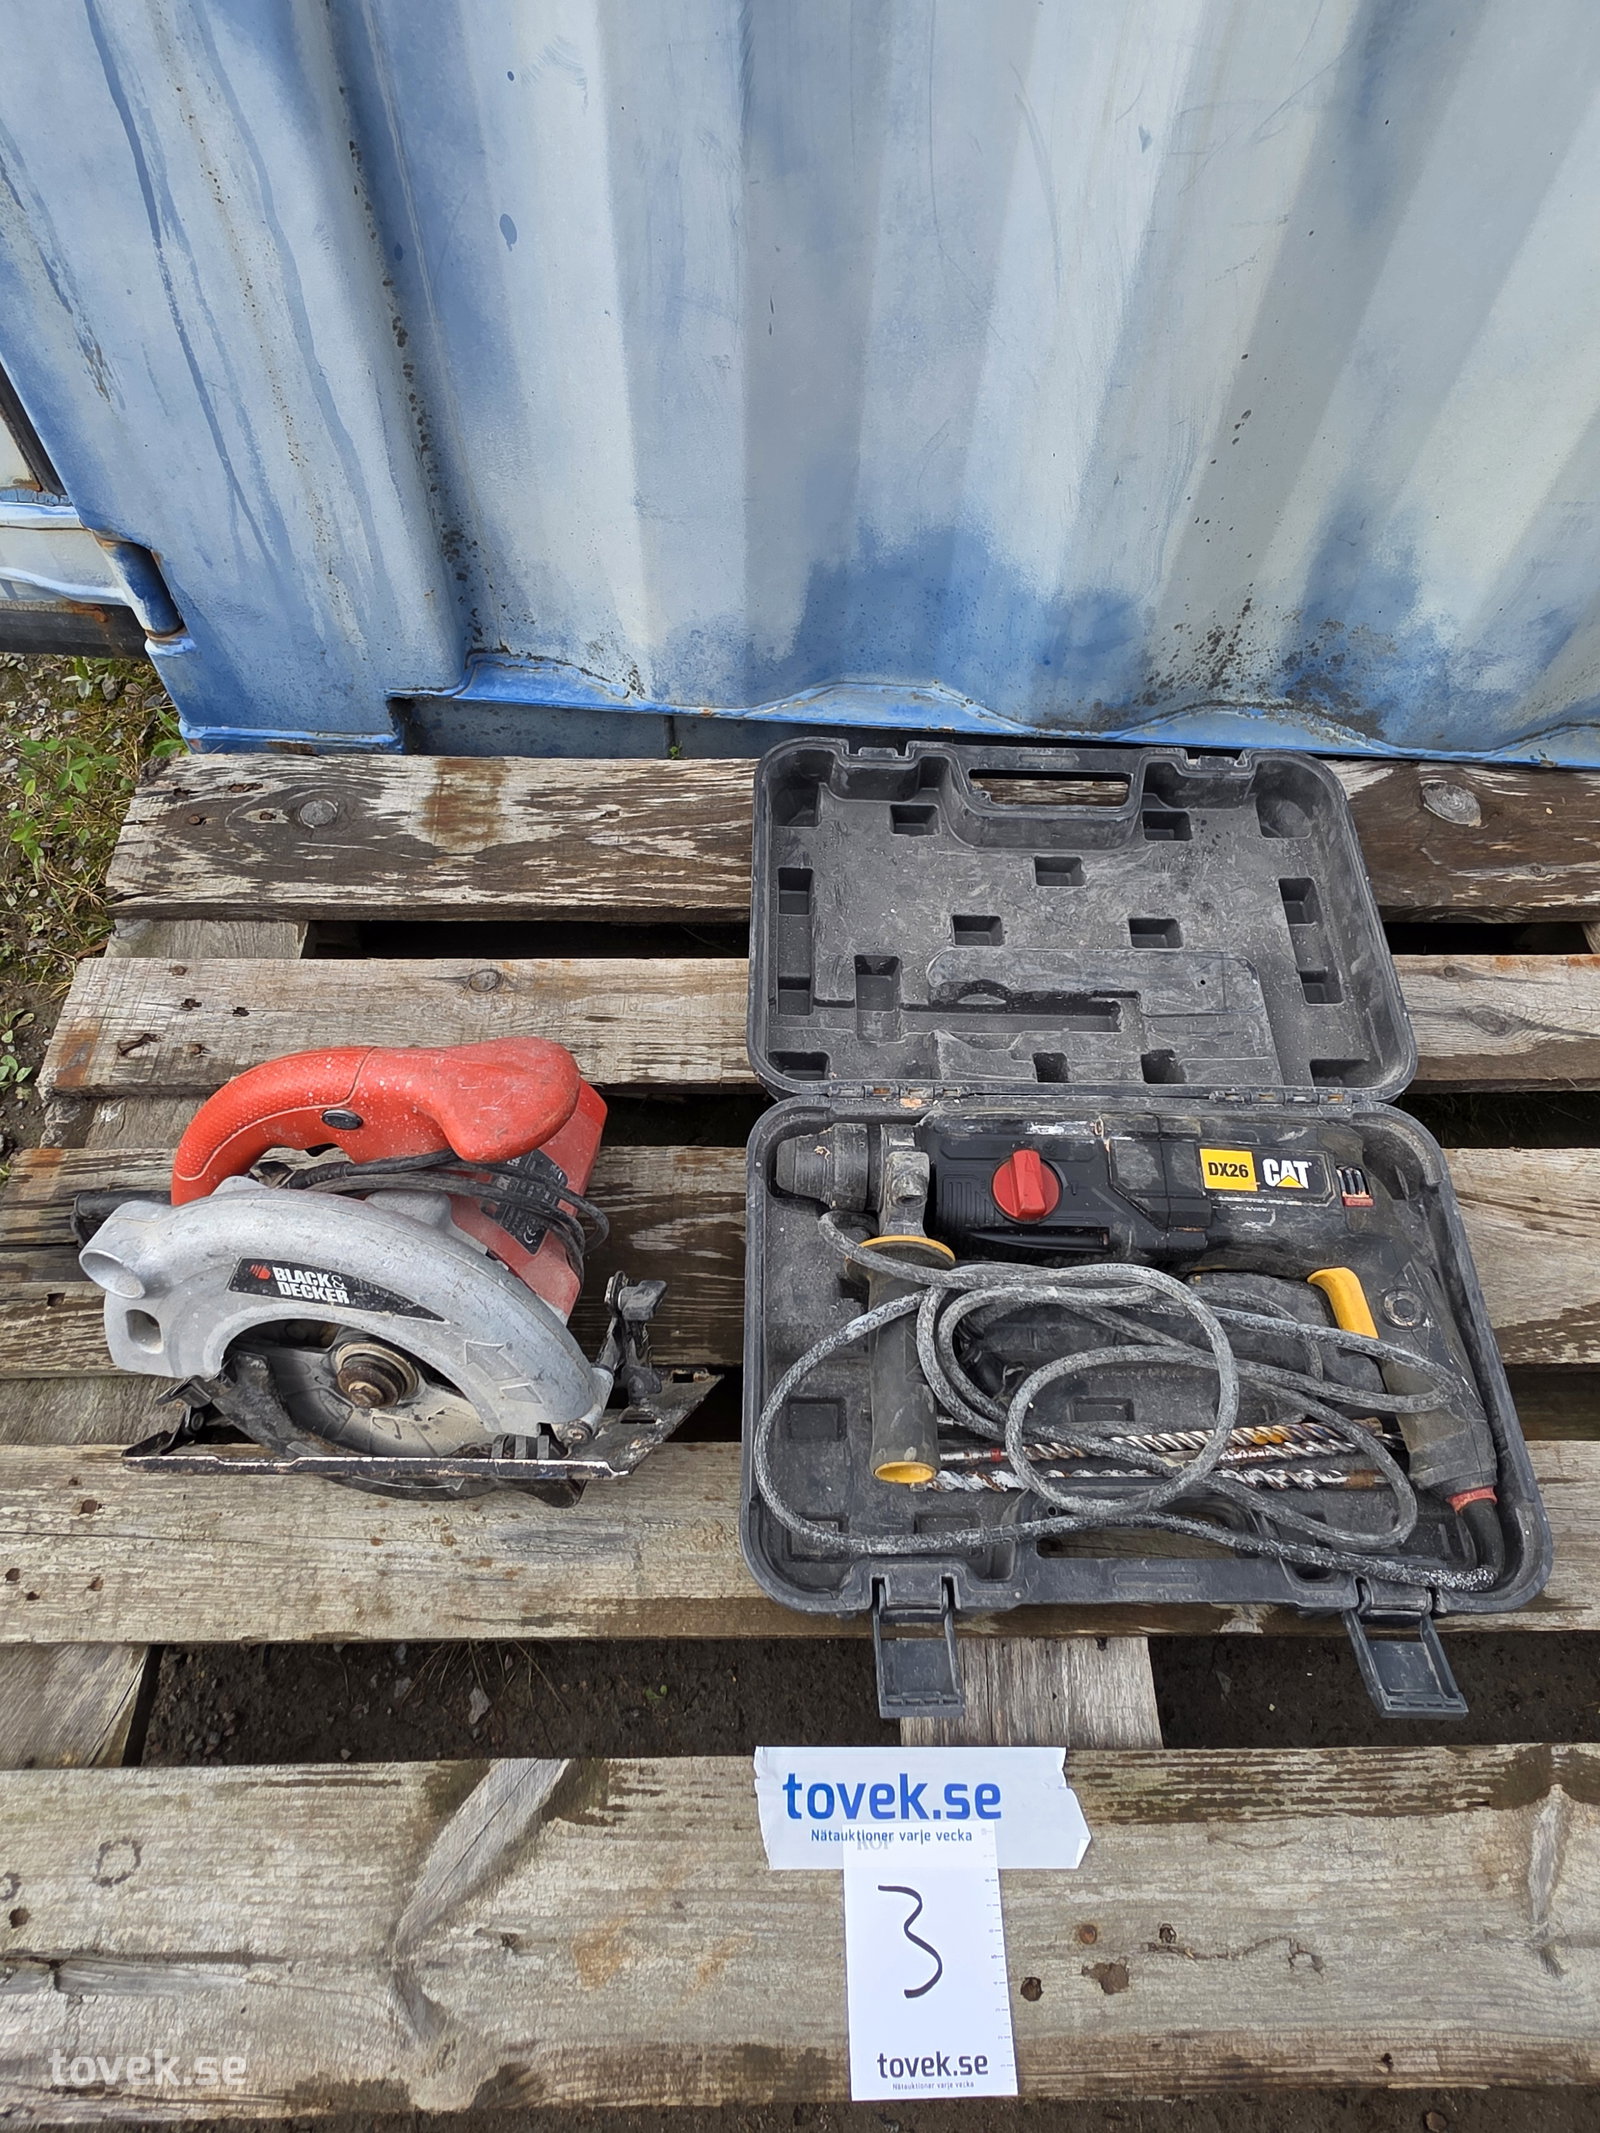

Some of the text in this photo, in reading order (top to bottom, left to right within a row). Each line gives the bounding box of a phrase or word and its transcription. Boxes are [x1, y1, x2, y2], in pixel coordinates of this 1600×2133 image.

[1208, 1158, 1312, 1189] DX26 CAT
[277, 1281, 350, 1304] DECKER
[782, 1773, 1002, 1820] tovek.se
[811, 1828, 972, 1845] Nätauktioner varje vecka
[877, 1884, 943, 1998] 3
[877, 2051, 989, 2078] tovek.se
